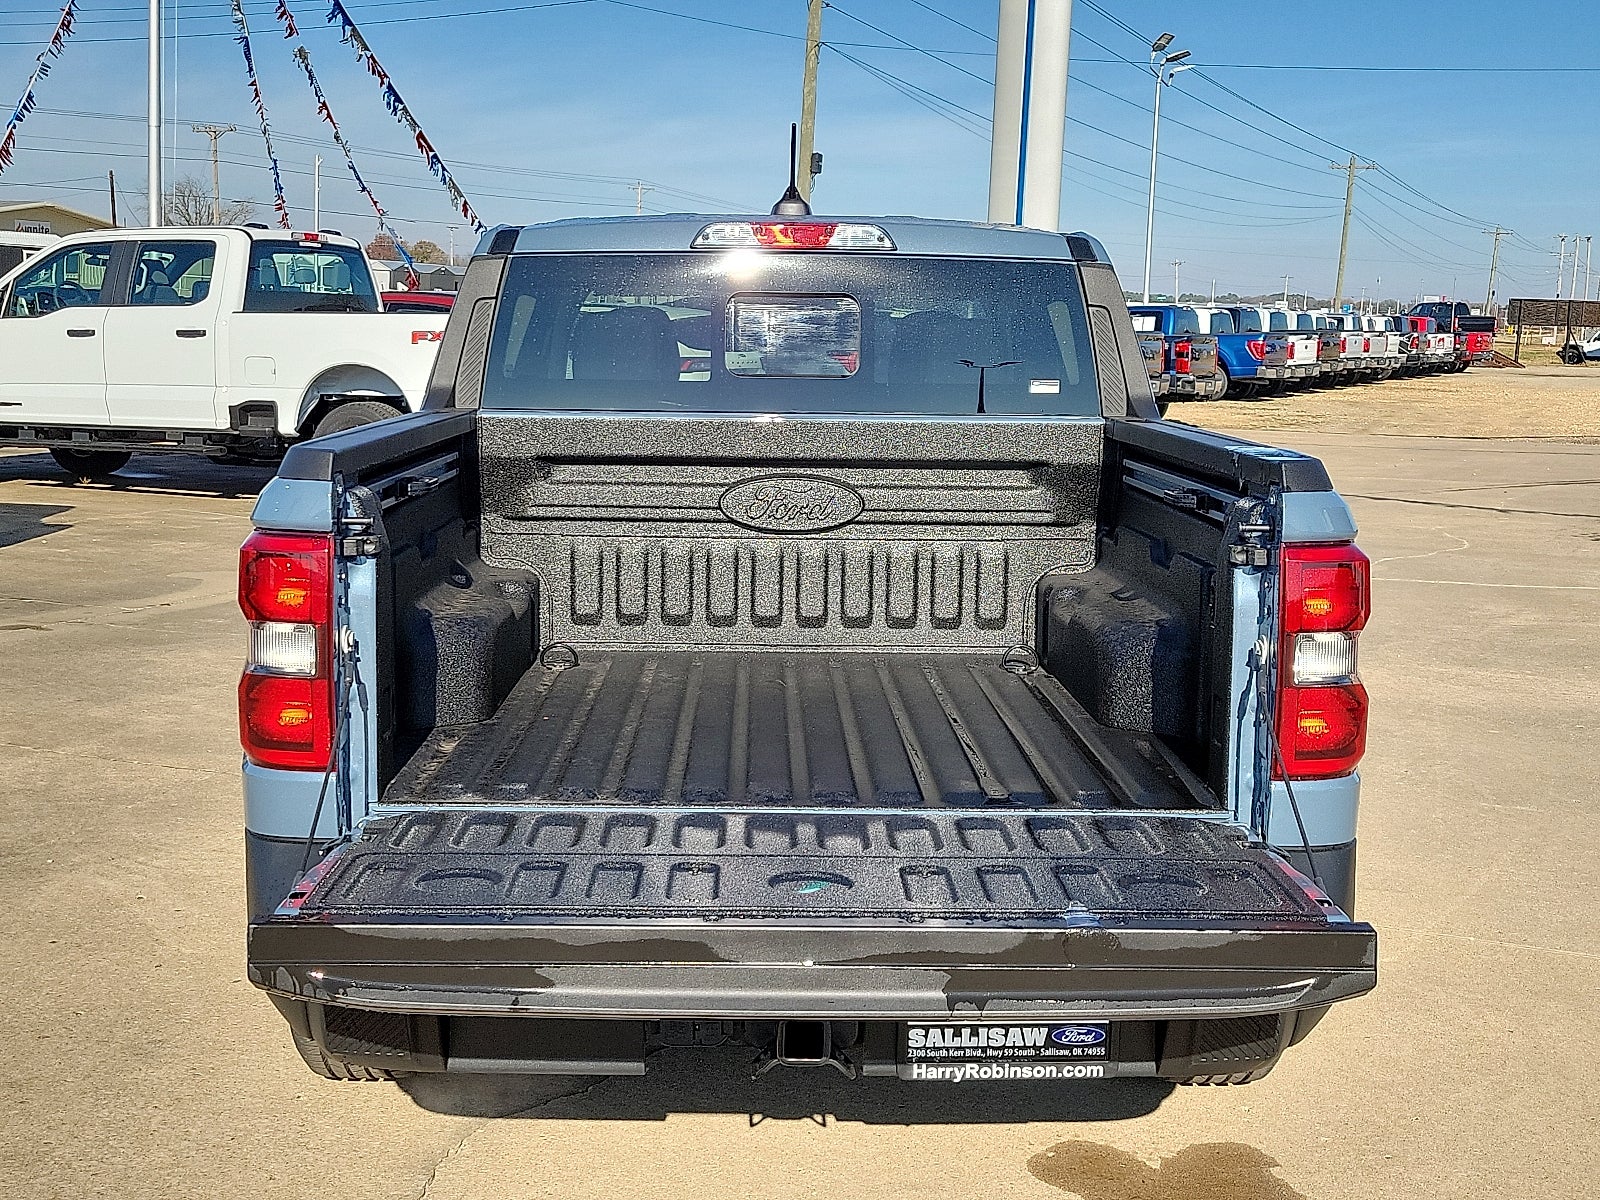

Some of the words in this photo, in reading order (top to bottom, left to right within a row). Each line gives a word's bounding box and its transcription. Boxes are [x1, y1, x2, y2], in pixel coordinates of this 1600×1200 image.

[746, 485, 838, 520] Ford
[908, 1027, 1048, 1047] SALLISAW
[1061, 1029, 1096, 1042] Ford
[907, 1048, 926, 1057] 2300
[926, 1048, 948, 1057] South
[949, 1048, 965, 1057] Kerr
[987, 1048, 1003, 1058] Hwy
[1004, 1048, 1013, 1056] 59
[1014, 1047, 1036, 1056] South
[1040, 1047, 1072, 1056] Sallisaw,
[1072, 1047, 1083, 1056] OK
[1083, 1047, 1106, 1056] 74955
[912, 1063, 1104, 1083] HarryRobinson.com
